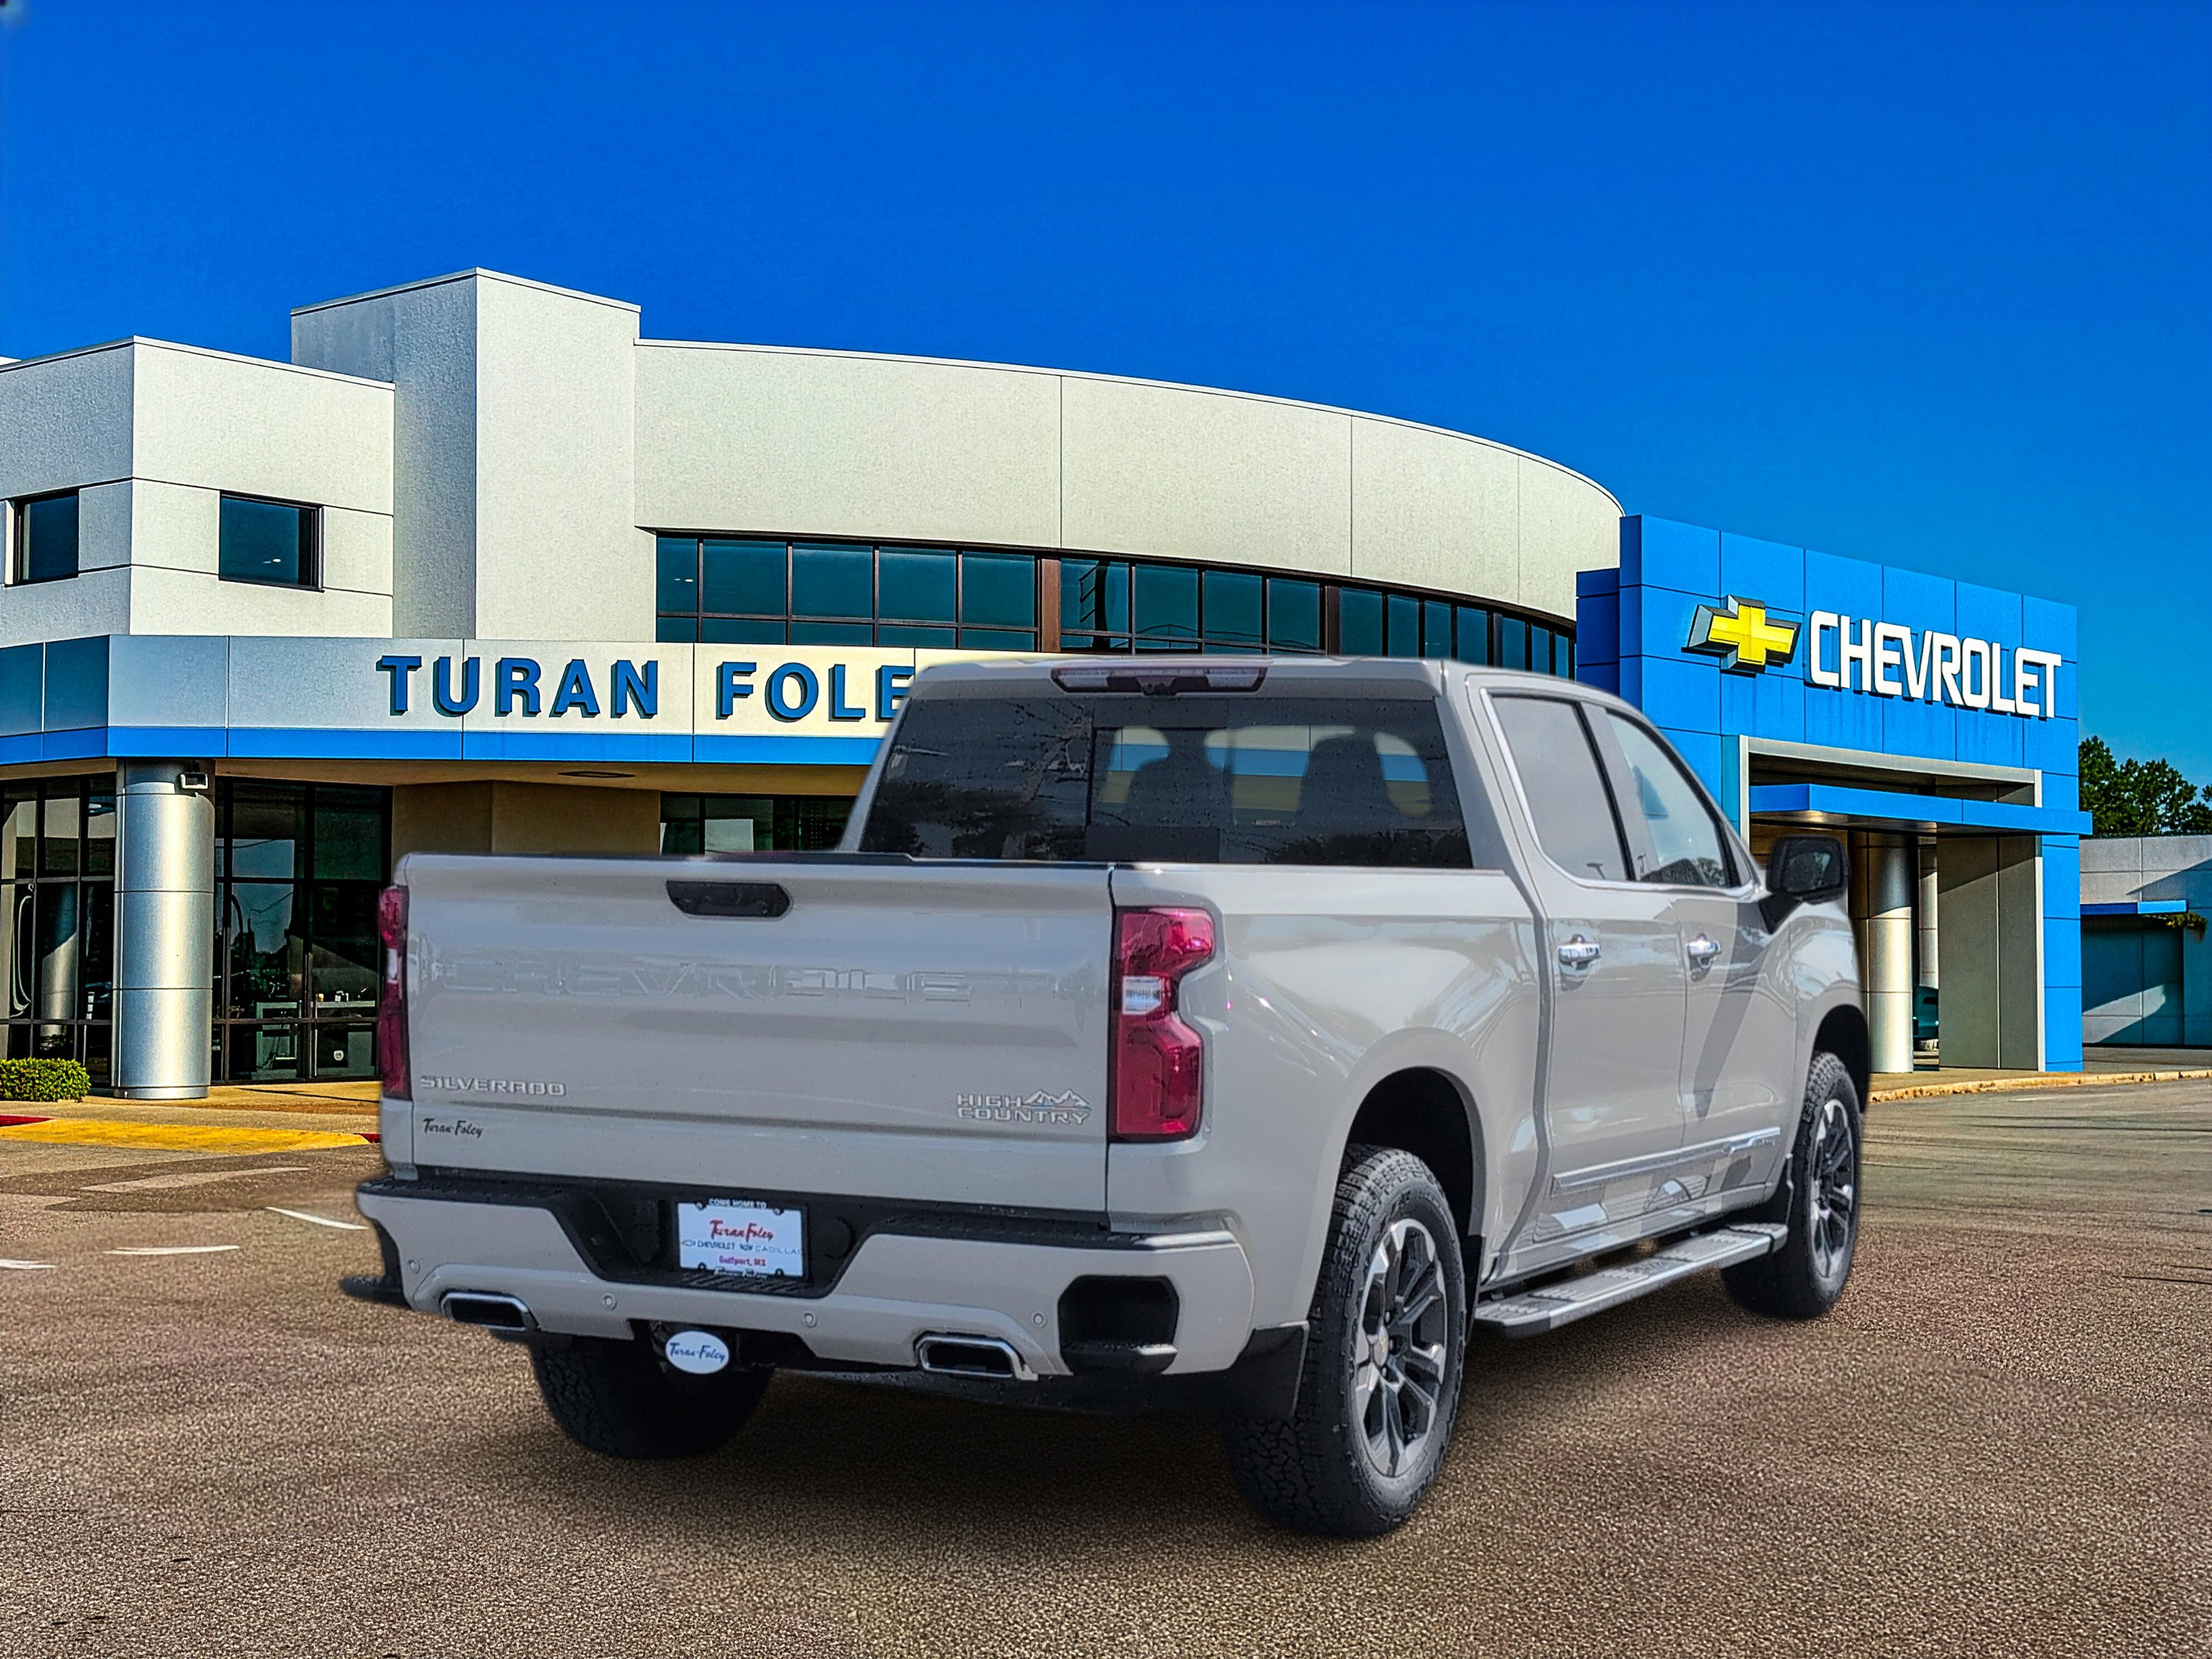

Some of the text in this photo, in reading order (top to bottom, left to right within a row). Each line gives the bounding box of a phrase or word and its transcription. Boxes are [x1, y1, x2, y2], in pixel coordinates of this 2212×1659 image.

[1810, 610, 2062, 718] CHEVROLET
[376, 655, 658, 719] TURAN
[421, 1075, 566, 1097] SILVERADO
[957, 1094, 1021, 1108] HIGH
[957, 1107, 1090, 1125] COUNTRY
